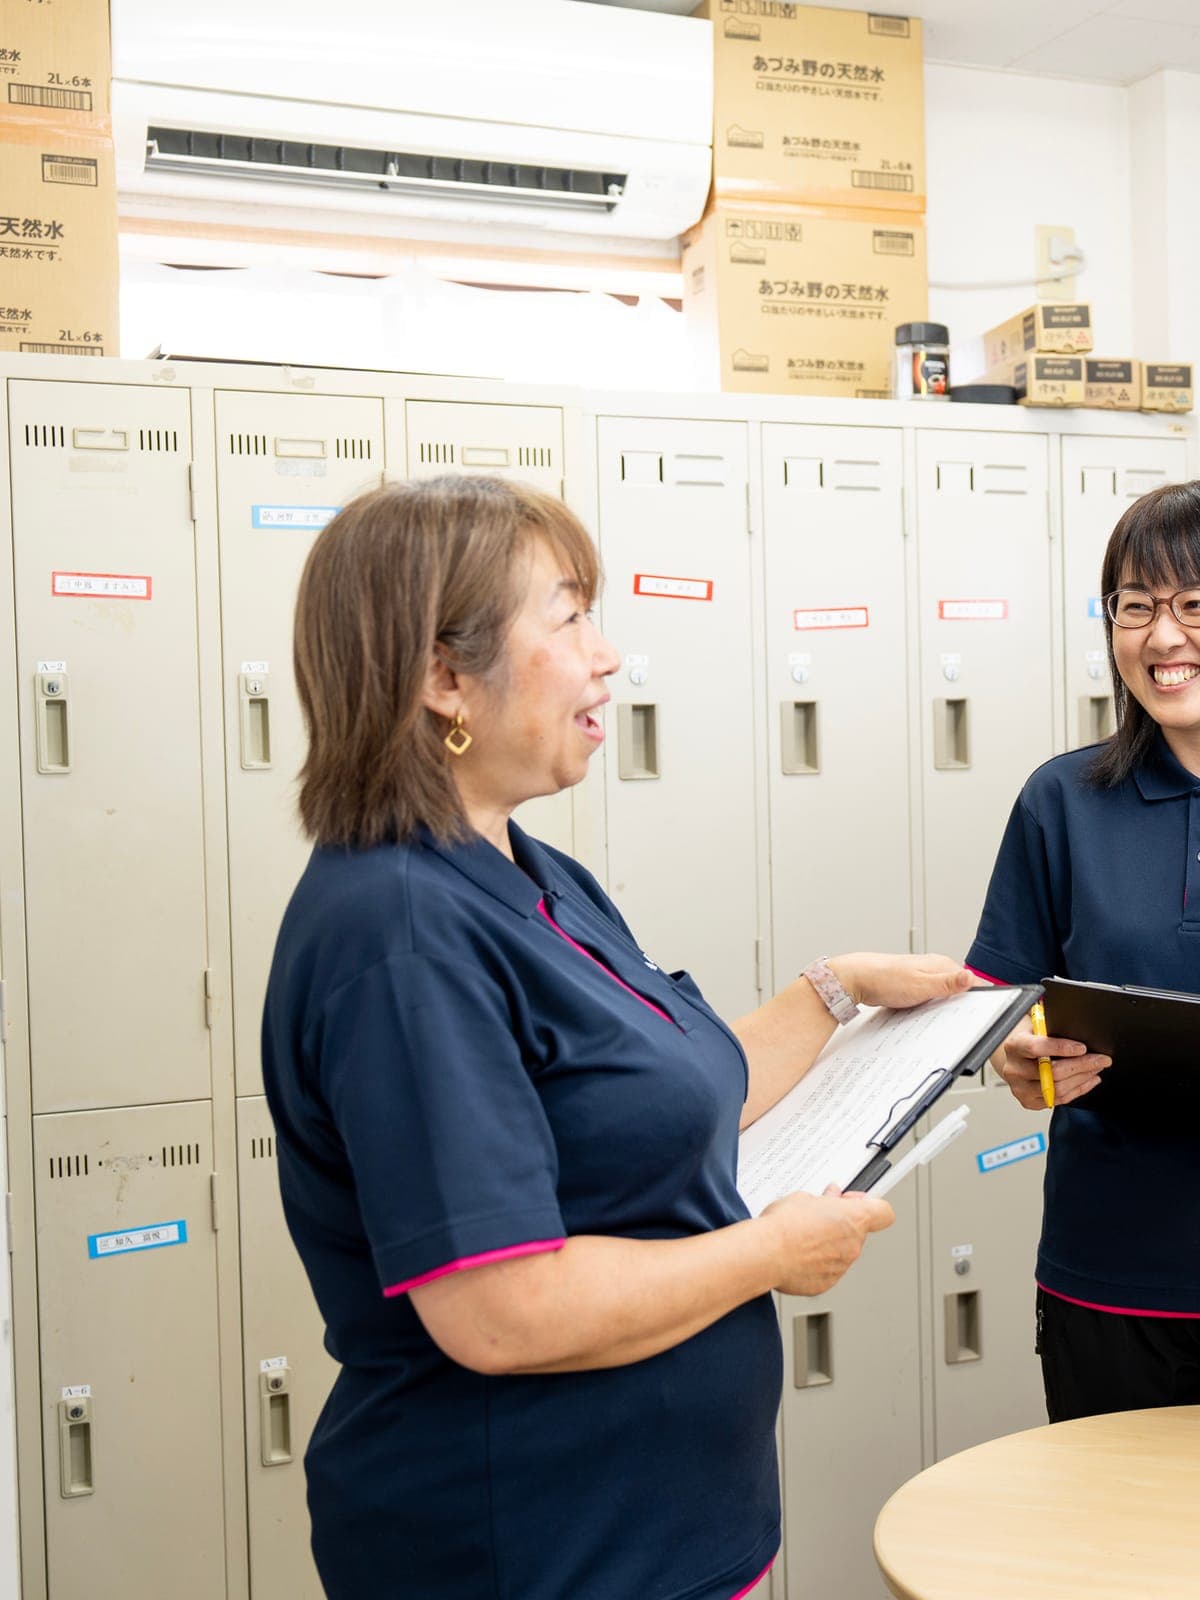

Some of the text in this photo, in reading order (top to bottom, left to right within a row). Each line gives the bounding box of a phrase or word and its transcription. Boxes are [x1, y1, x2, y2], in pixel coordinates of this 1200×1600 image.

[752, 55, 885, 83] あづみ野の天然水
[0, 216, 65, 240] 天然水
[758, 279, 889, 302] あづみ野の天然水
